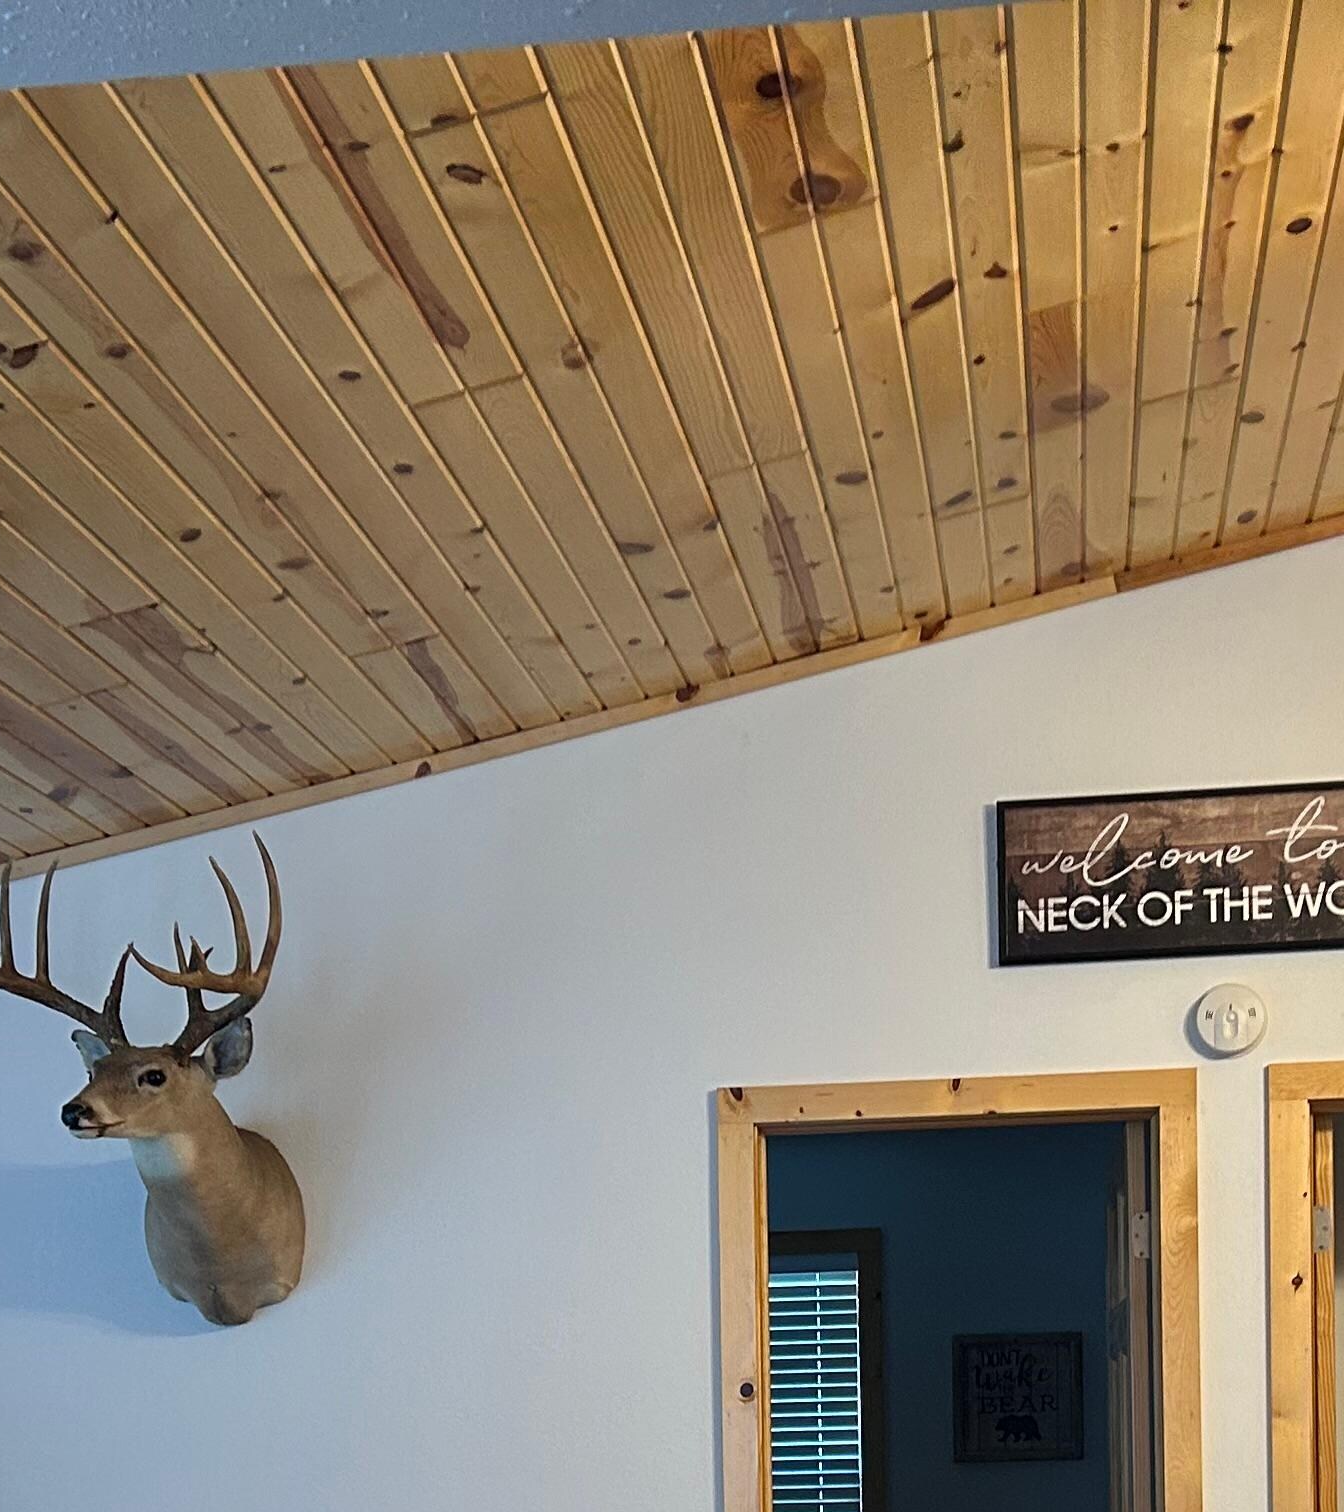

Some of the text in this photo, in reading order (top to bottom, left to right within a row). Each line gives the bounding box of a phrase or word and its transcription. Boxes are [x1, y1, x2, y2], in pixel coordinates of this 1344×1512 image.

[1021, 812, 1254, 887] welcome
[1017, 895, 1128, 935] NECK
[1137, 890, 1197, 928] OF
[1203, 884, 1275, 924] THE
[979, 1394, 1059, 1414] BEAR
